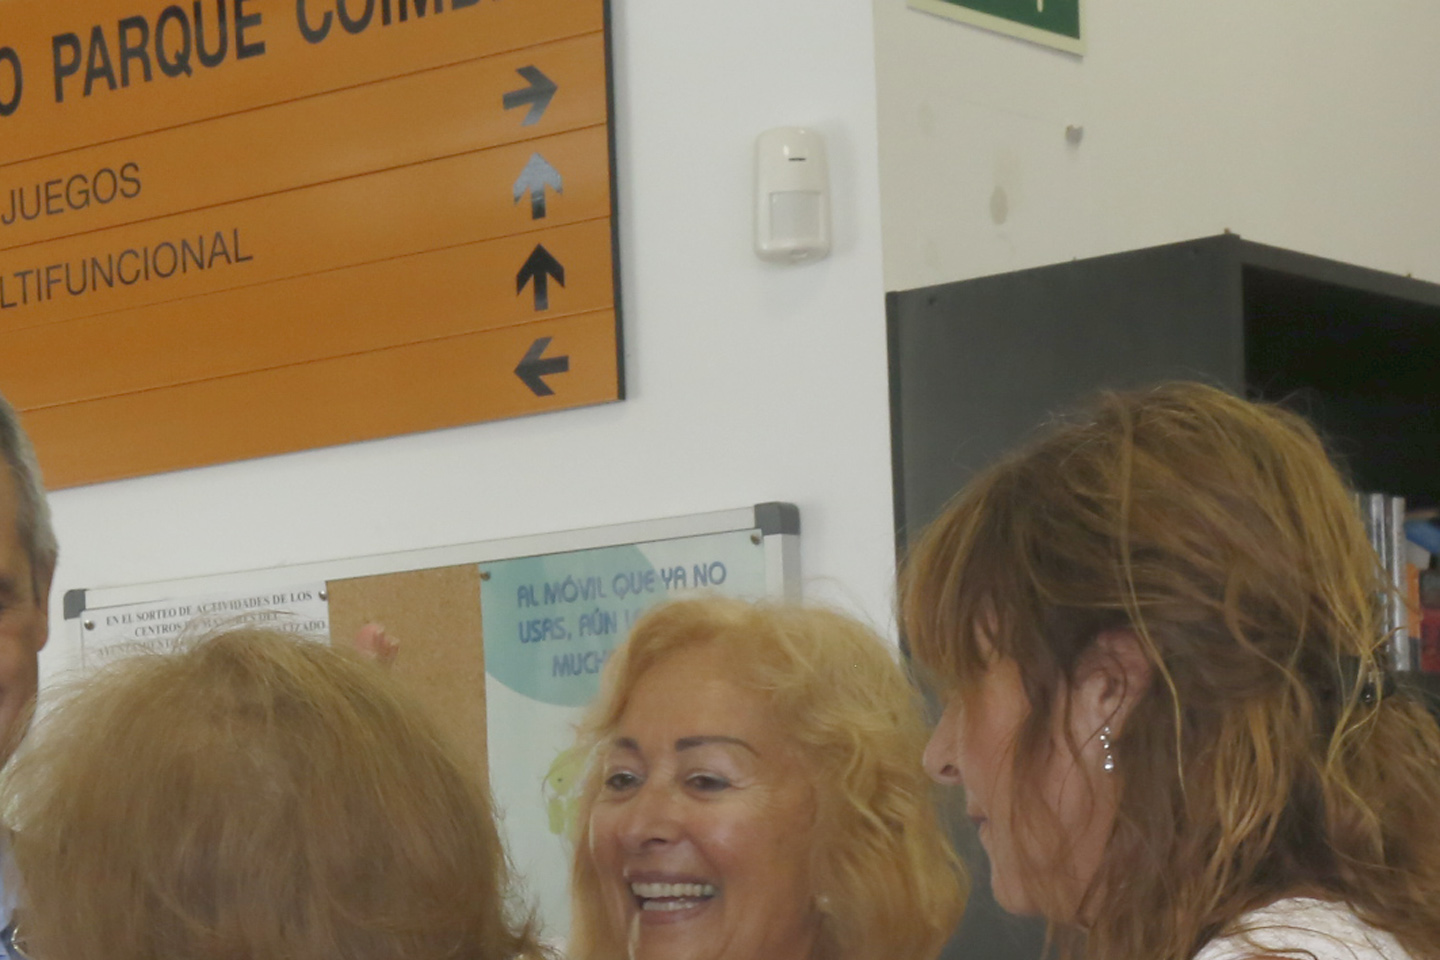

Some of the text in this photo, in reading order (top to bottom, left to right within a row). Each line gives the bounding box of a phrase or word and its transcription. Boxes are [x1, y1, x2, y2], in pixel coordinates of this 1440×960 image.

[52, 0, 266, 103] PARQUE
[1, 162, 142, 226] JUEGOS
[516, 561, 727, 608] AL MÓVIL QUE YA NO
[106, 591, 312, 627] EN EL SORTEO DE ACTIVIDADES DE LOS
[134, 623, 182, 637] CENTROS
[518, 617, 572, 644] USAS,
[579, 607, 617, 637] AÚN
